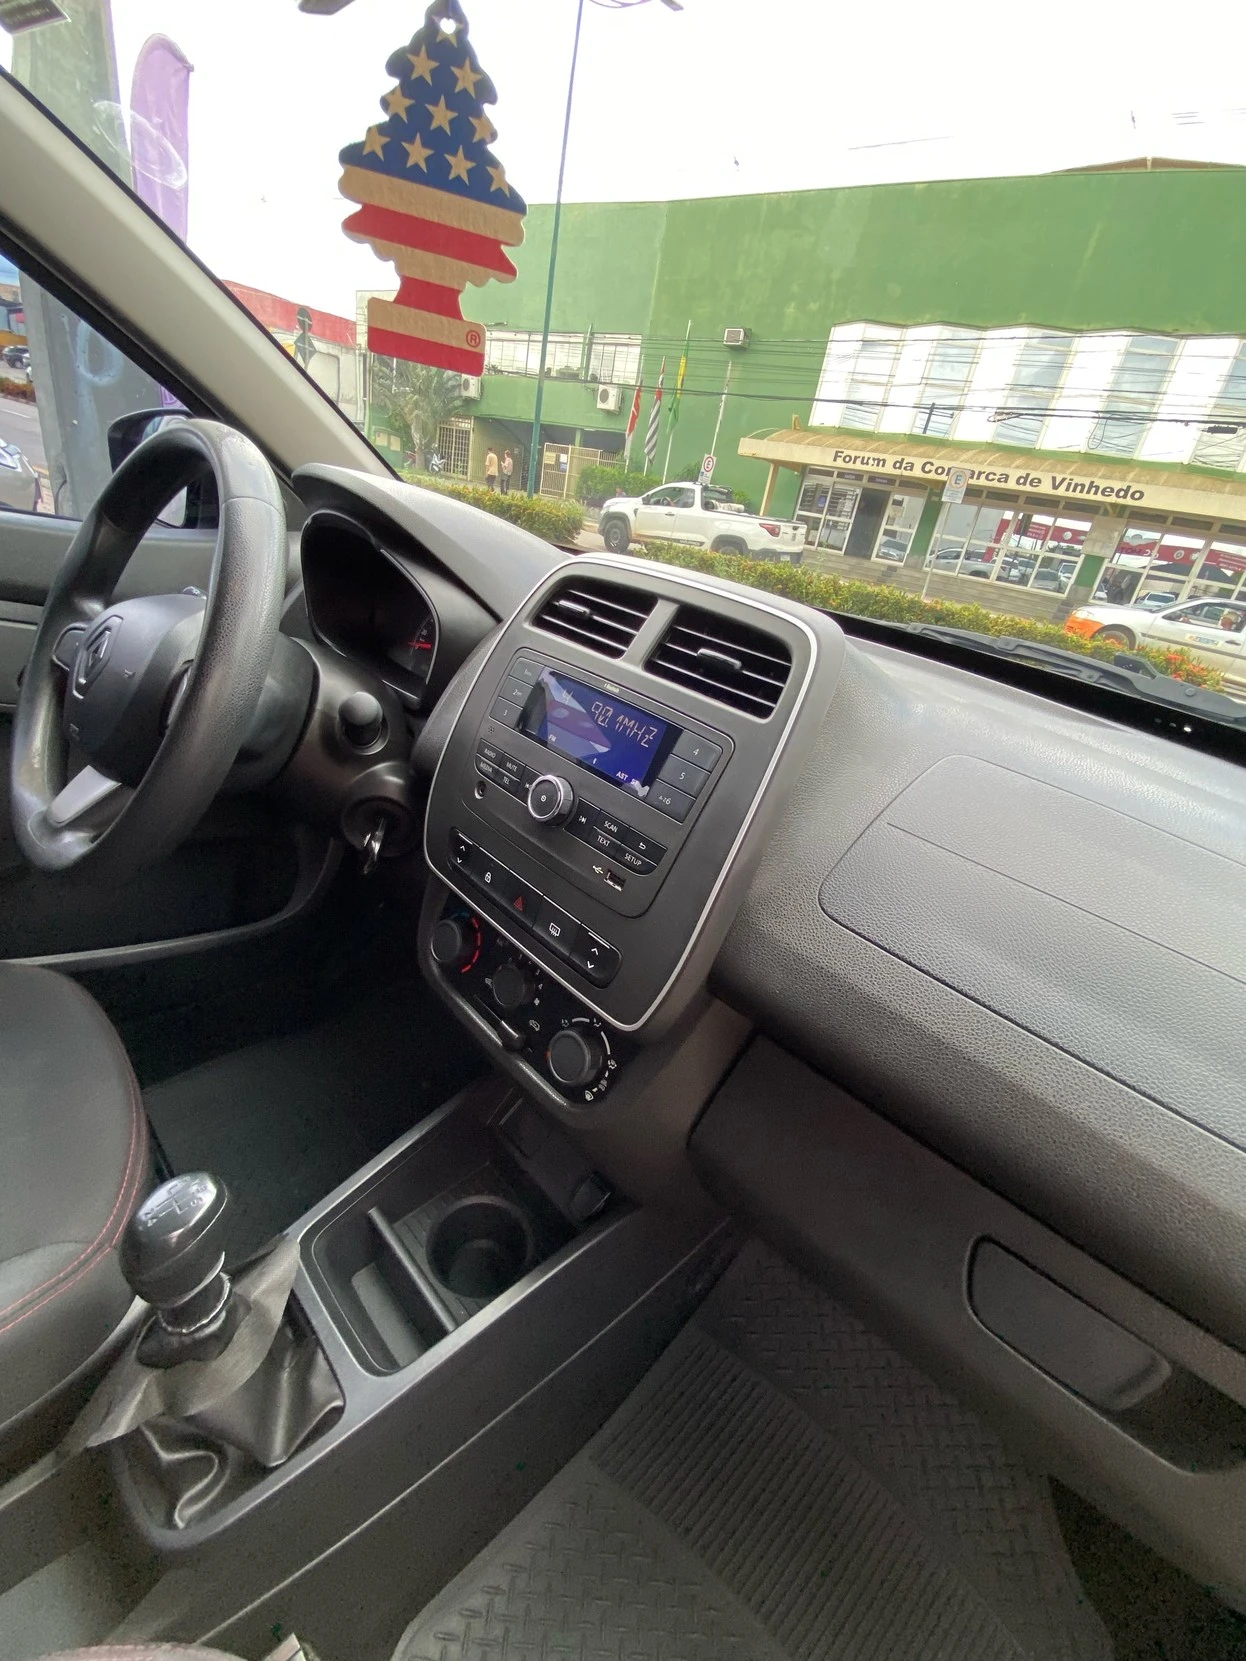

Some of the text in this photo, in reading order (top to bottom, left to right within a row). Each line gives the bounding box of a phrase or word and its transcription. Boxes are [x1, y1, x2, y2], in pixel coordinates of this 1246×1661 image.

[833, 450, 1145, 502] Forum da Coarca de Vinhedo
[954, 474, 963, 485] E
[548, 734, 557, 742] FM
[484, 748, 497, 759] RADIO
[692, 748, 700, 756] 4
[480, 761, 493, 773] MEDIA
[506, 761, 518, 773] MUTE
[502, 776, 510, 785] TEL
[615, 771, 629, 781] AST
[679, 772, 686, 780] 5
[603, 820, 618, 833] SCAN
[596, 835, 611, 847] TEXT
[624, 852, 642, 866] SETUP
